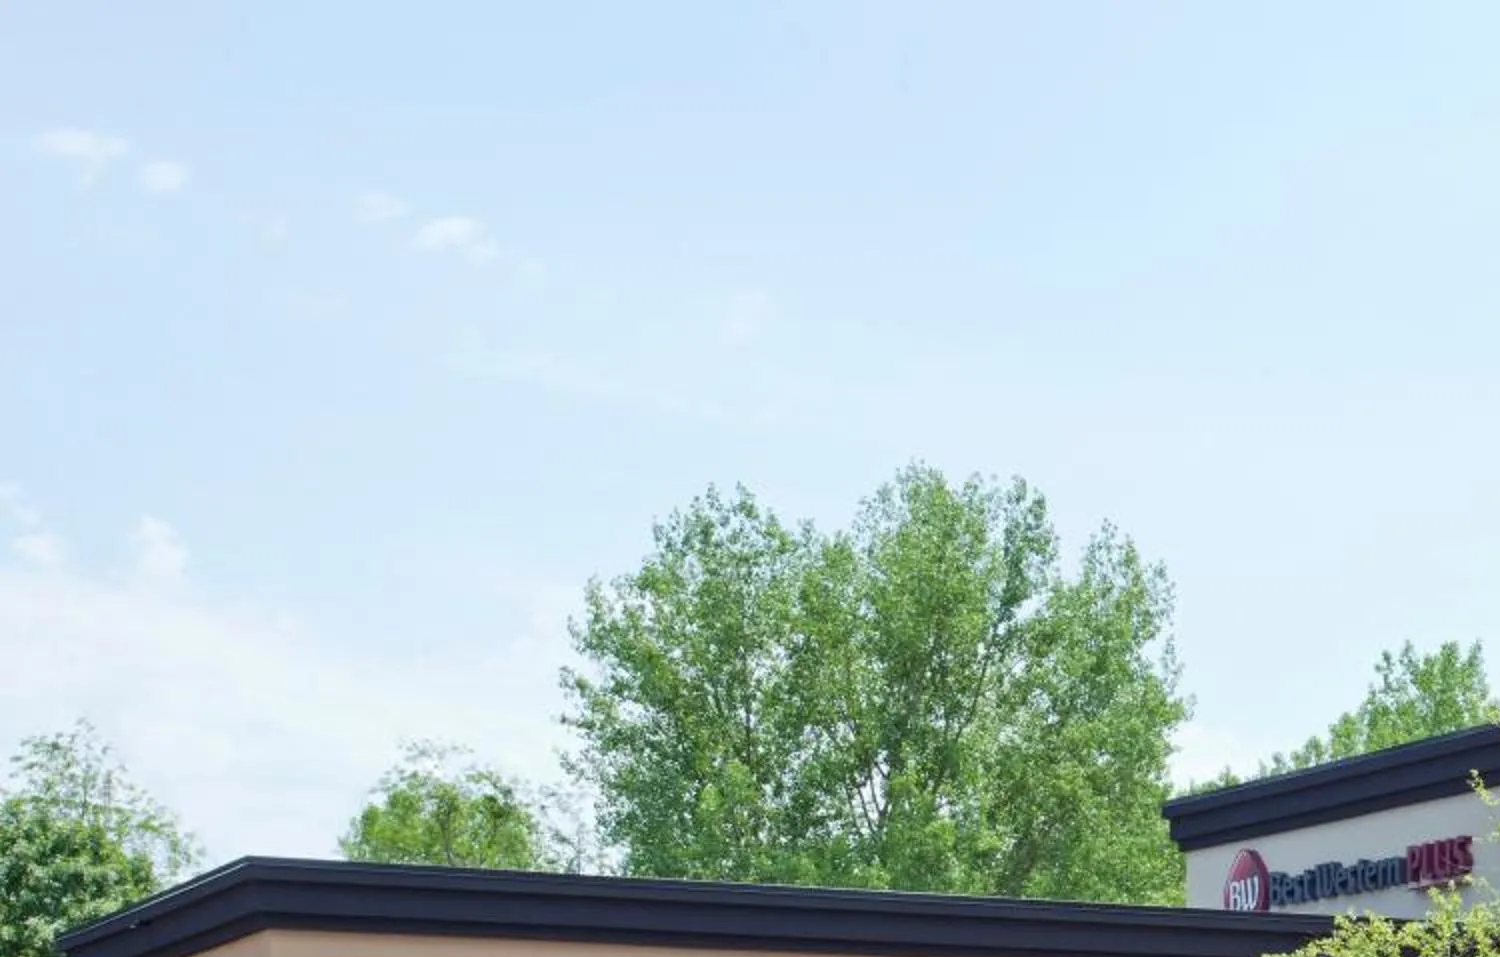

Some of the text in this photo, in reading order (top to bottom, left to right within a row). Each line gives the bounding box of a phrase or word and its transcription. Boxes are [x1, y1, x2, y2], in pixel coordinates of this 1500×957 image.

[1228, 876, 1260, 911] BW
[1270, 837, 1472, 905] Best Western PLUS
